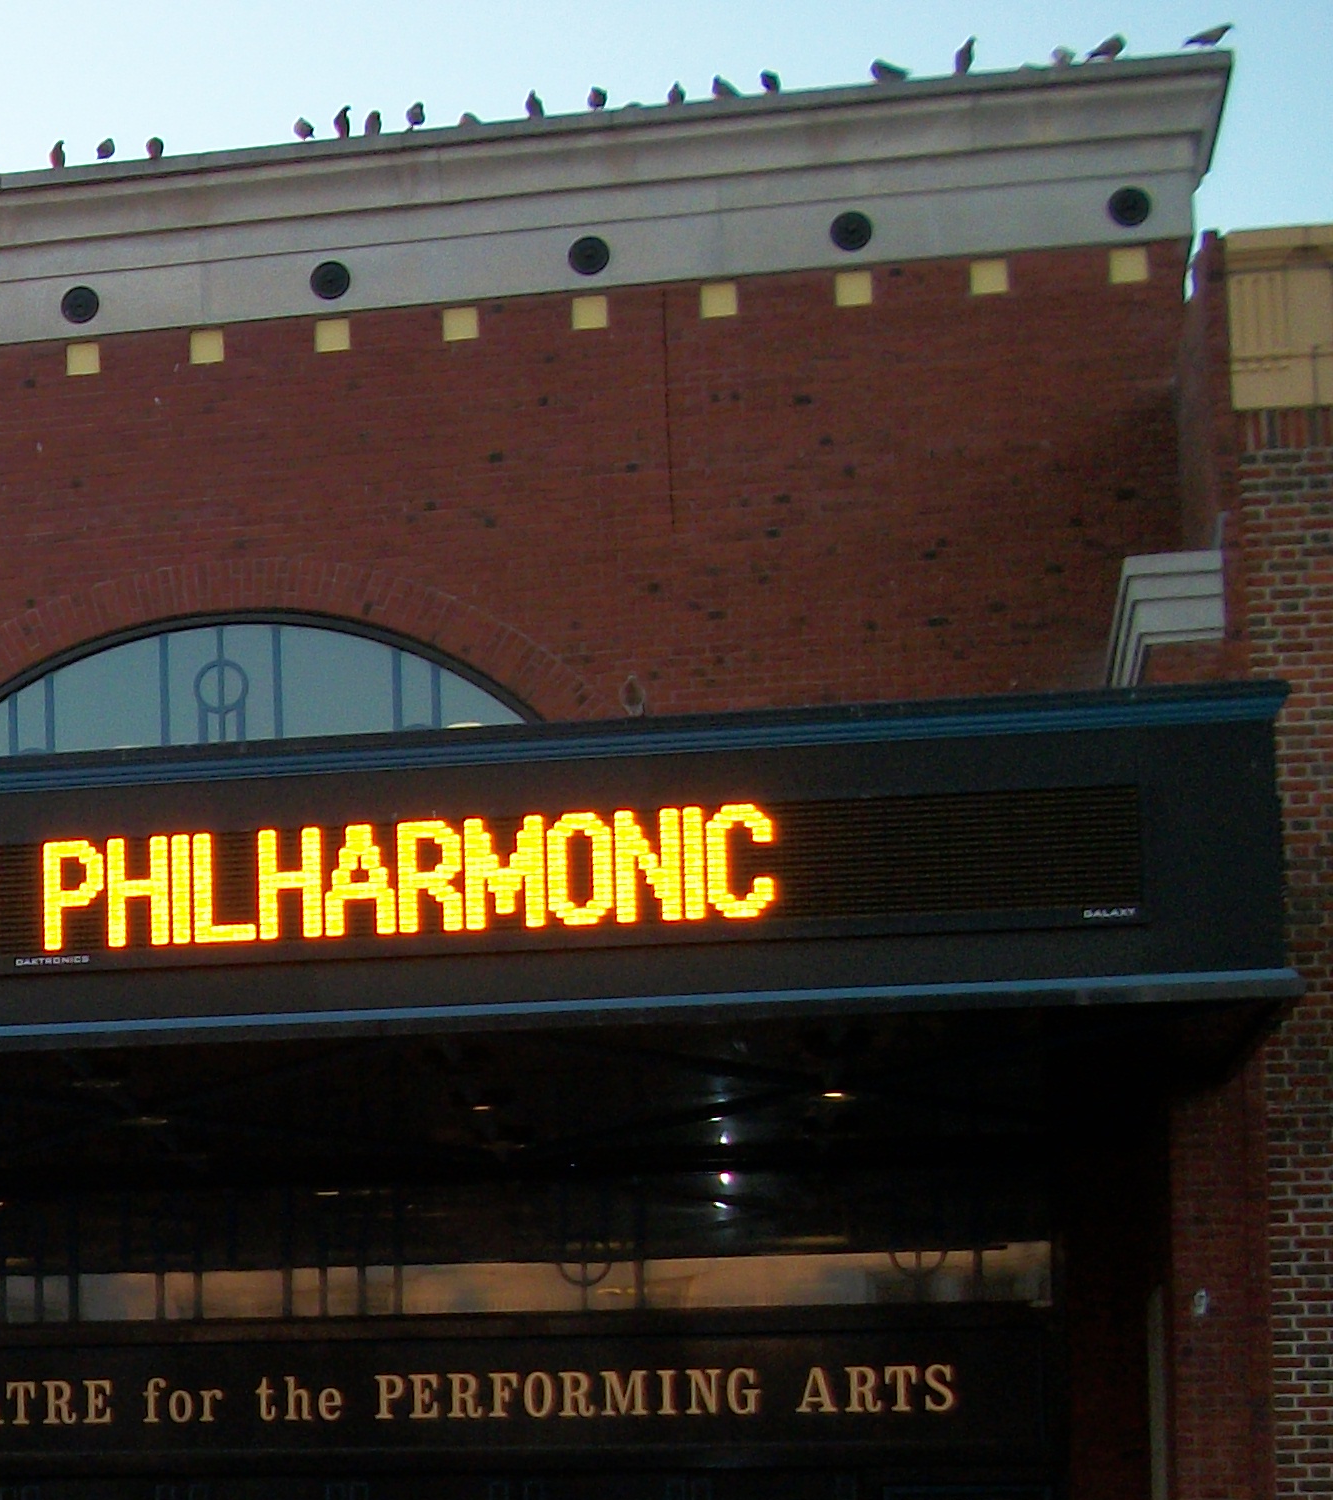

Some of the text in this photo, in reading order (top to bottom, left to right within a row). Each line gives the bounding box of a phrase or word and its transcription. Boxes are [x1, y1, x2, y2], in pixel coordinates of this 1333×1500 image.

[40, 801, 780, 954] PHILHARMONIC
[141, 1376, 225, 1424] for
[254, 1374, 344, 1423] the
[373, 1366, 763, 1421] PERFORMING
[795, 1362, 958, 1415] ARTS
